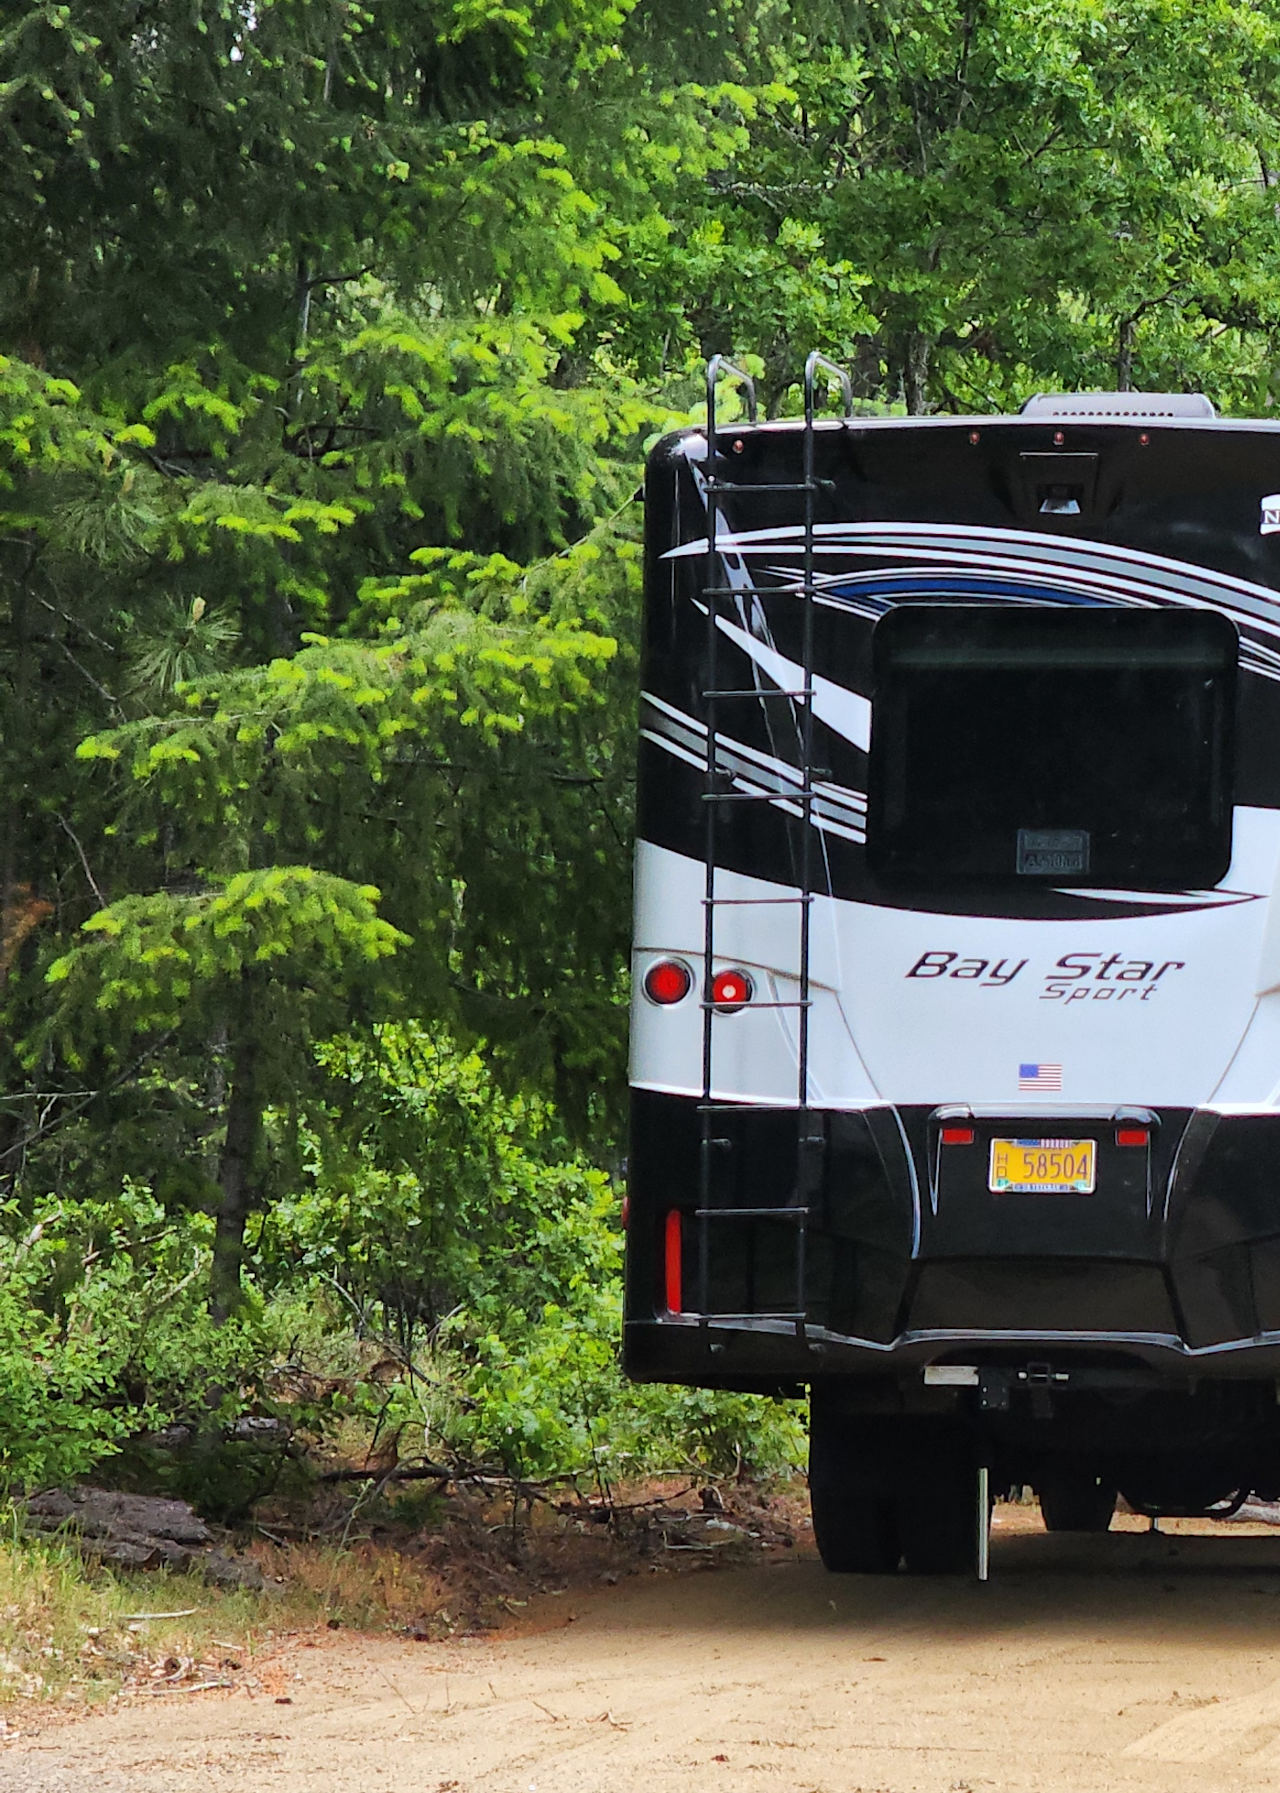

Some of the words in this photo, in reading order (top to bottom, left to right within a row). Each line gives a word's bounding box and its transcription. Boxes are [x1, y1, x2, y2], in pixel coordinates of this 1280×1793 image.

[905, 952, 1030, 986] Bay
[1045, 952, 1186, 981] Star
[1039, 983, 1158, 1004] Sport
[1023, 1153, 1087, 1179] 58504
